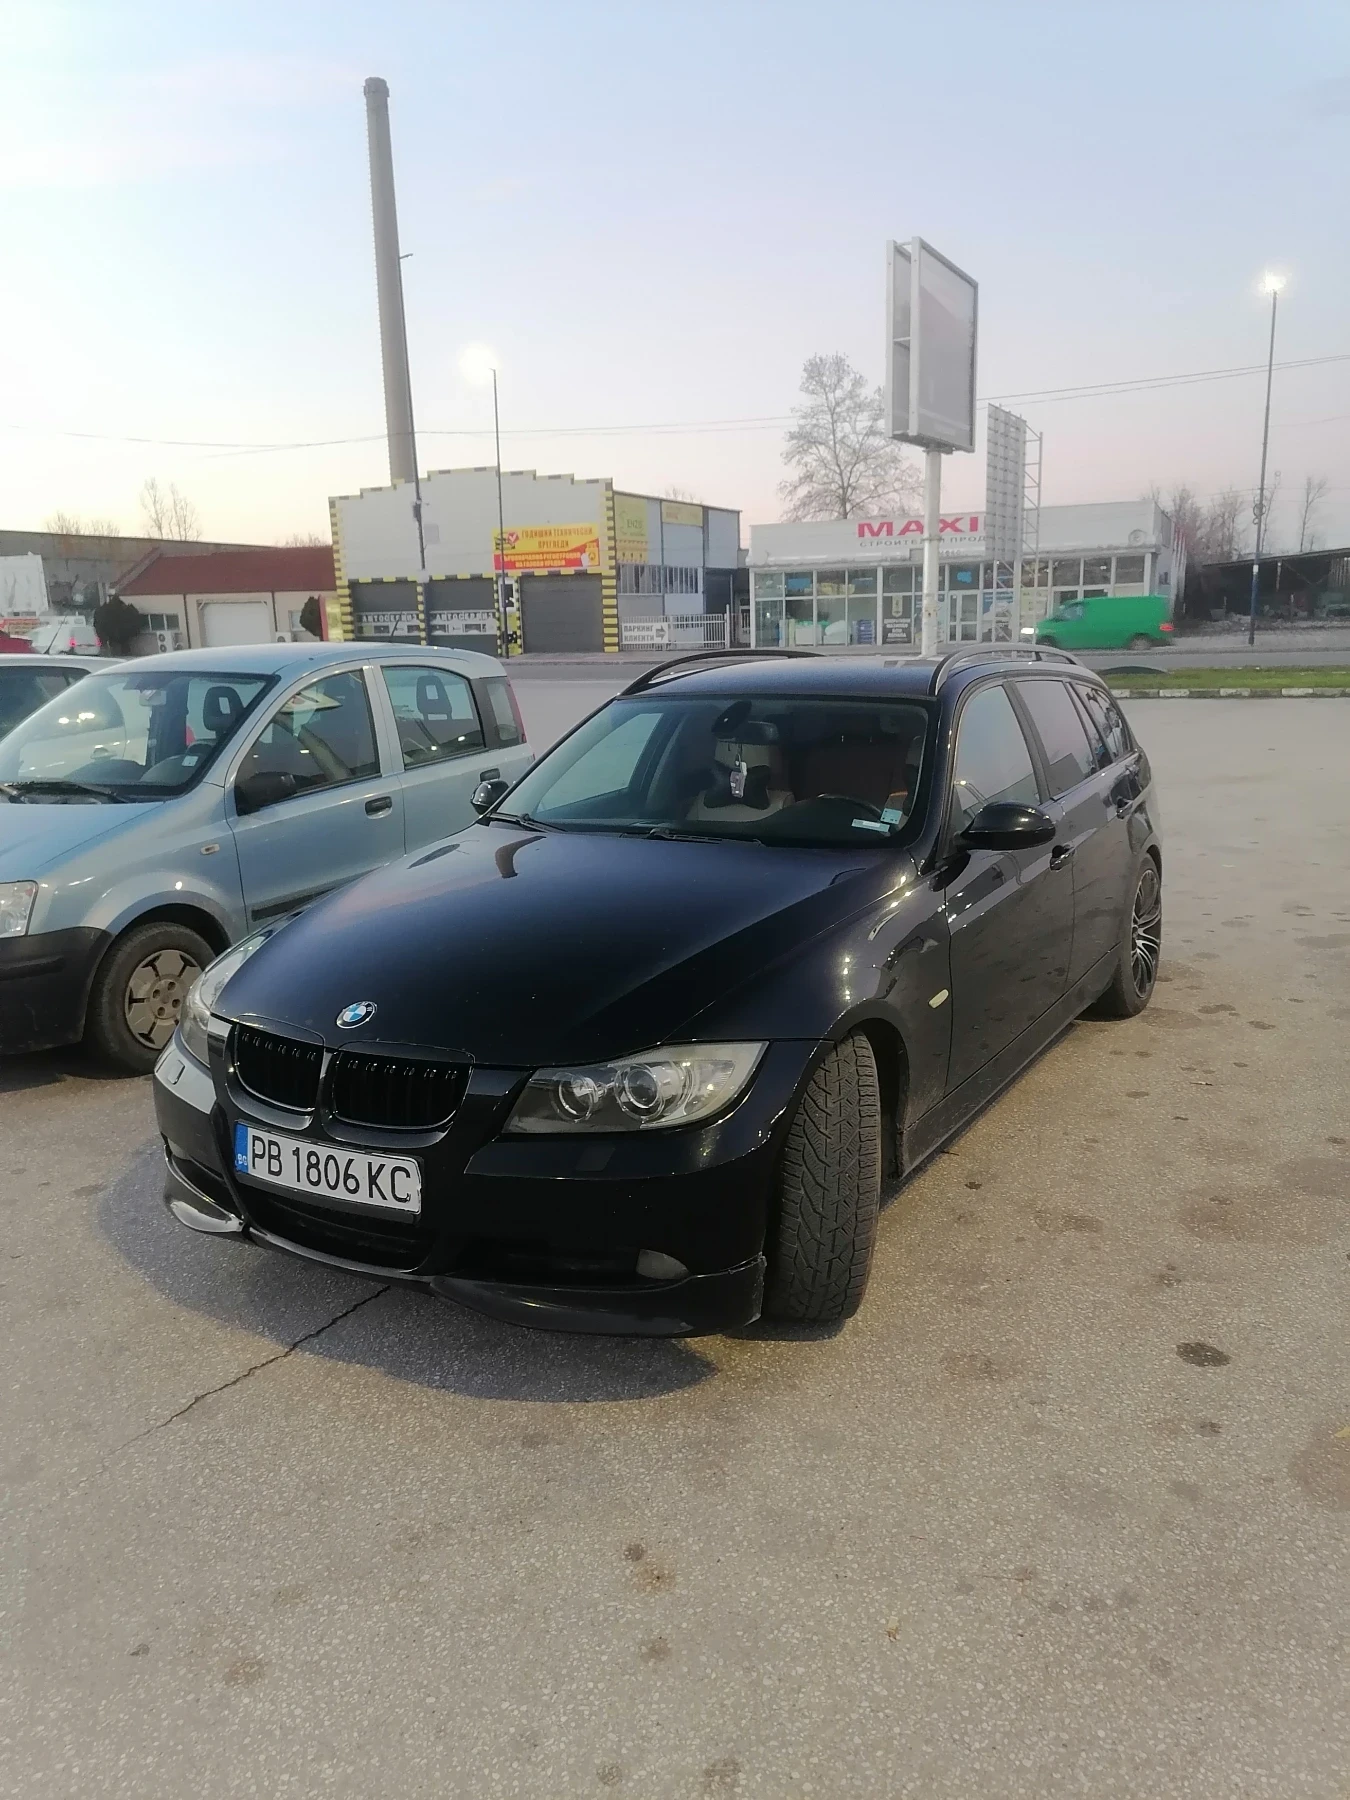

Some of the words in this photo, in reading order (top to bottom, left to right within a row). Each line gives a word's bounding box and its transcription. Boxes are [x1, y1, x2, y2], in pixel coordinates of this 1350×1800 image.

[858, 516, 979, 538] MAXI
[950, 535, 987, 543] ПРОД
[623, 625, 654, 633] ПАРКИНГ
[624, 634, 655, 642] КЛИЕНТИ
[252, 1134, 283, 1177] PB
[292, 1146, 360, 1195] 1806
[367, 1161, 412, 1203] KC
